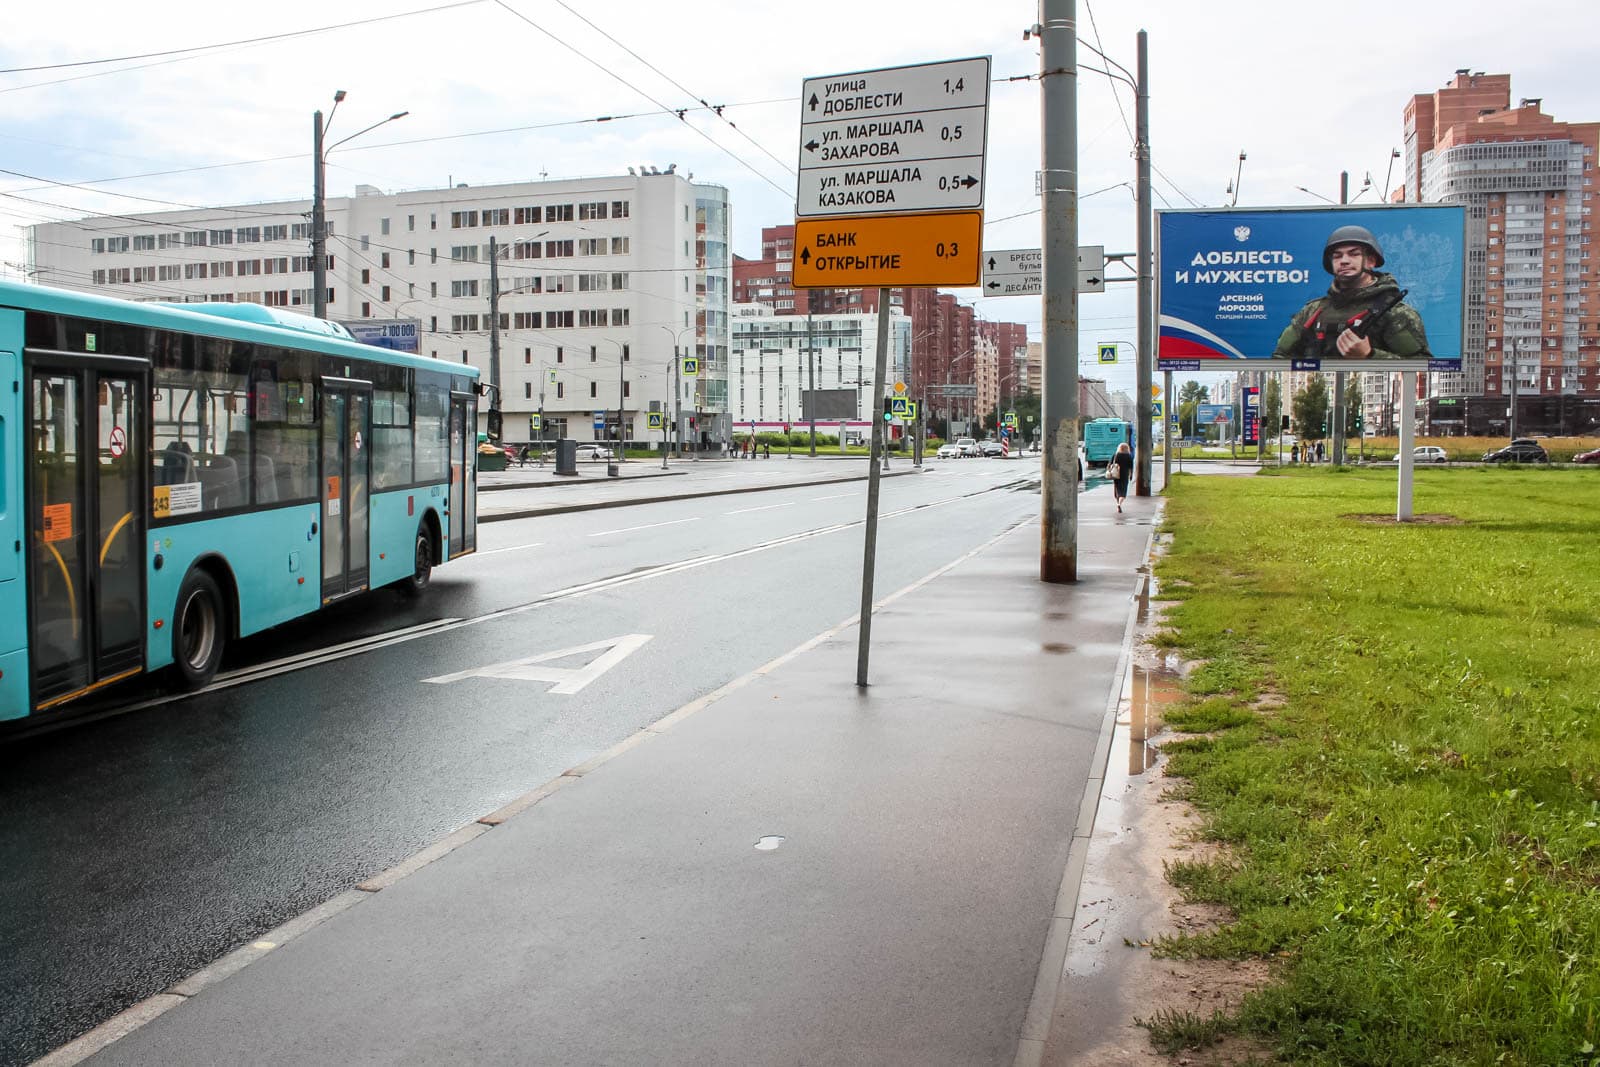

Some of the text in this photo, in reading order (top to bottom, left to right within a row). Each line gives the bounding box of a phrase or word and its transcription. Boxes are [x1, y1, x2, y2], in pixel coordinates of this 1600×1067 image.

[825, 79, 866, 97] улица
[943, 77, 964, 95] 1,4
[823, 92, 903, 116] ДОБЛЕСТИ
[822, 119, 924, 145] ул. МАРШАЛА
[940, 125, 962, 143] 0,5
[821, 141, 899, 161] ЗАХАРОВА
[820, 167, 922, 191] ул. МАРШАЛА
[938, 175, 960, 192] 0,5
[818, 189, 896, 207] КАЗАКОВА
[816, 232, 857, 248] БАНК
[936, 242, 959, 259] 0,3
[1191, 251, 1294, 267] ДОБЛЕСТЬ
[815, 254, 901, 271] ОТКРЫТИЕ
[1175, 269, 1309, 284] И МУЖЕСТВО!
[1220, 293, 1264, 302] АРСЕНИЙ
[1218, 304, 1265, 312] МОРОЗОВ
[382, 325, 387, 336] 2
[388, 325, 400, 336] 100
[401, 324, 415, 336] 000
[153, 496, 170, 511] 243
